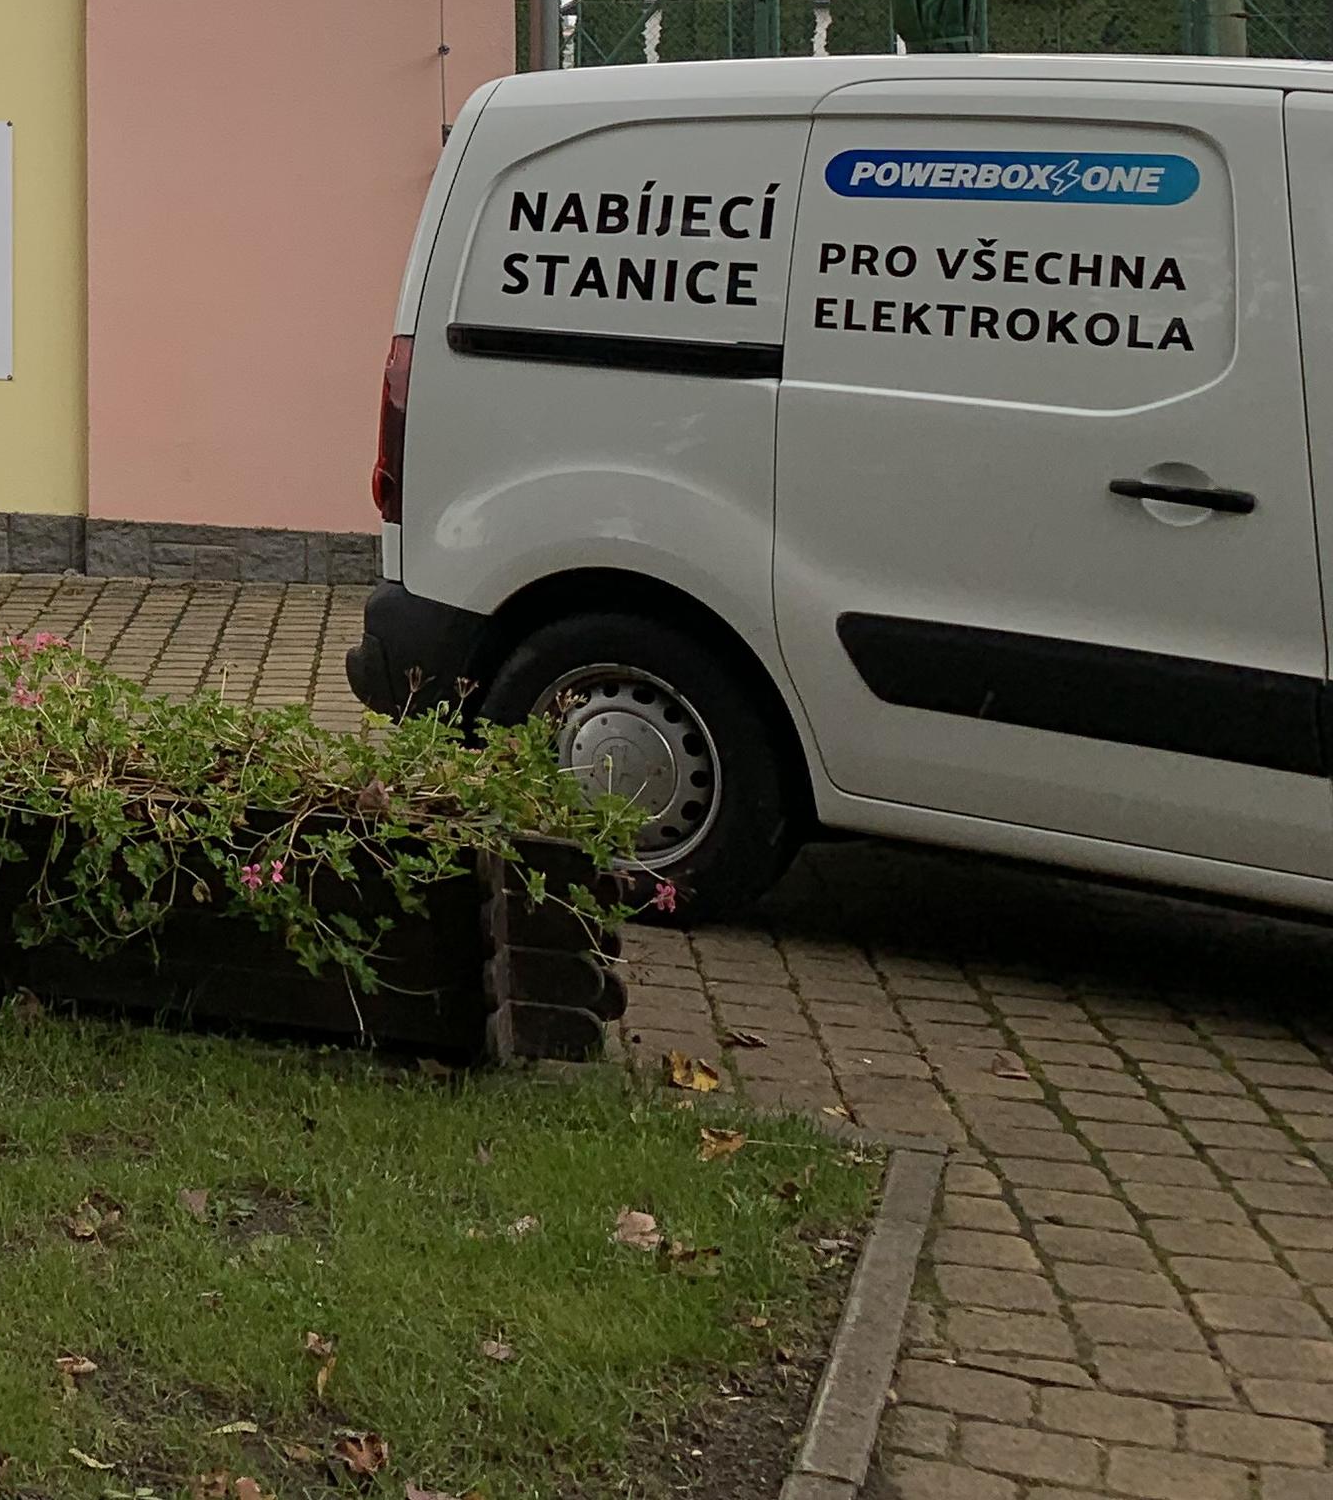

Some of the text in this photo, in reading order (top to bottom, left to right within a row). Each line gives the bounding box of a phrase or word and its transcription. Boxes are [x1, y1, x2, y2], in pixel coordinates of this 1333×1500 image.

[508, 180, 781, 241] NABÍJECÍ
[500, 251, 760, 308] STANICE
[817, 236, 1188, 292] PRO VŠECHNA
[813, 296, 1196, 353] ELEKTROKOLA
